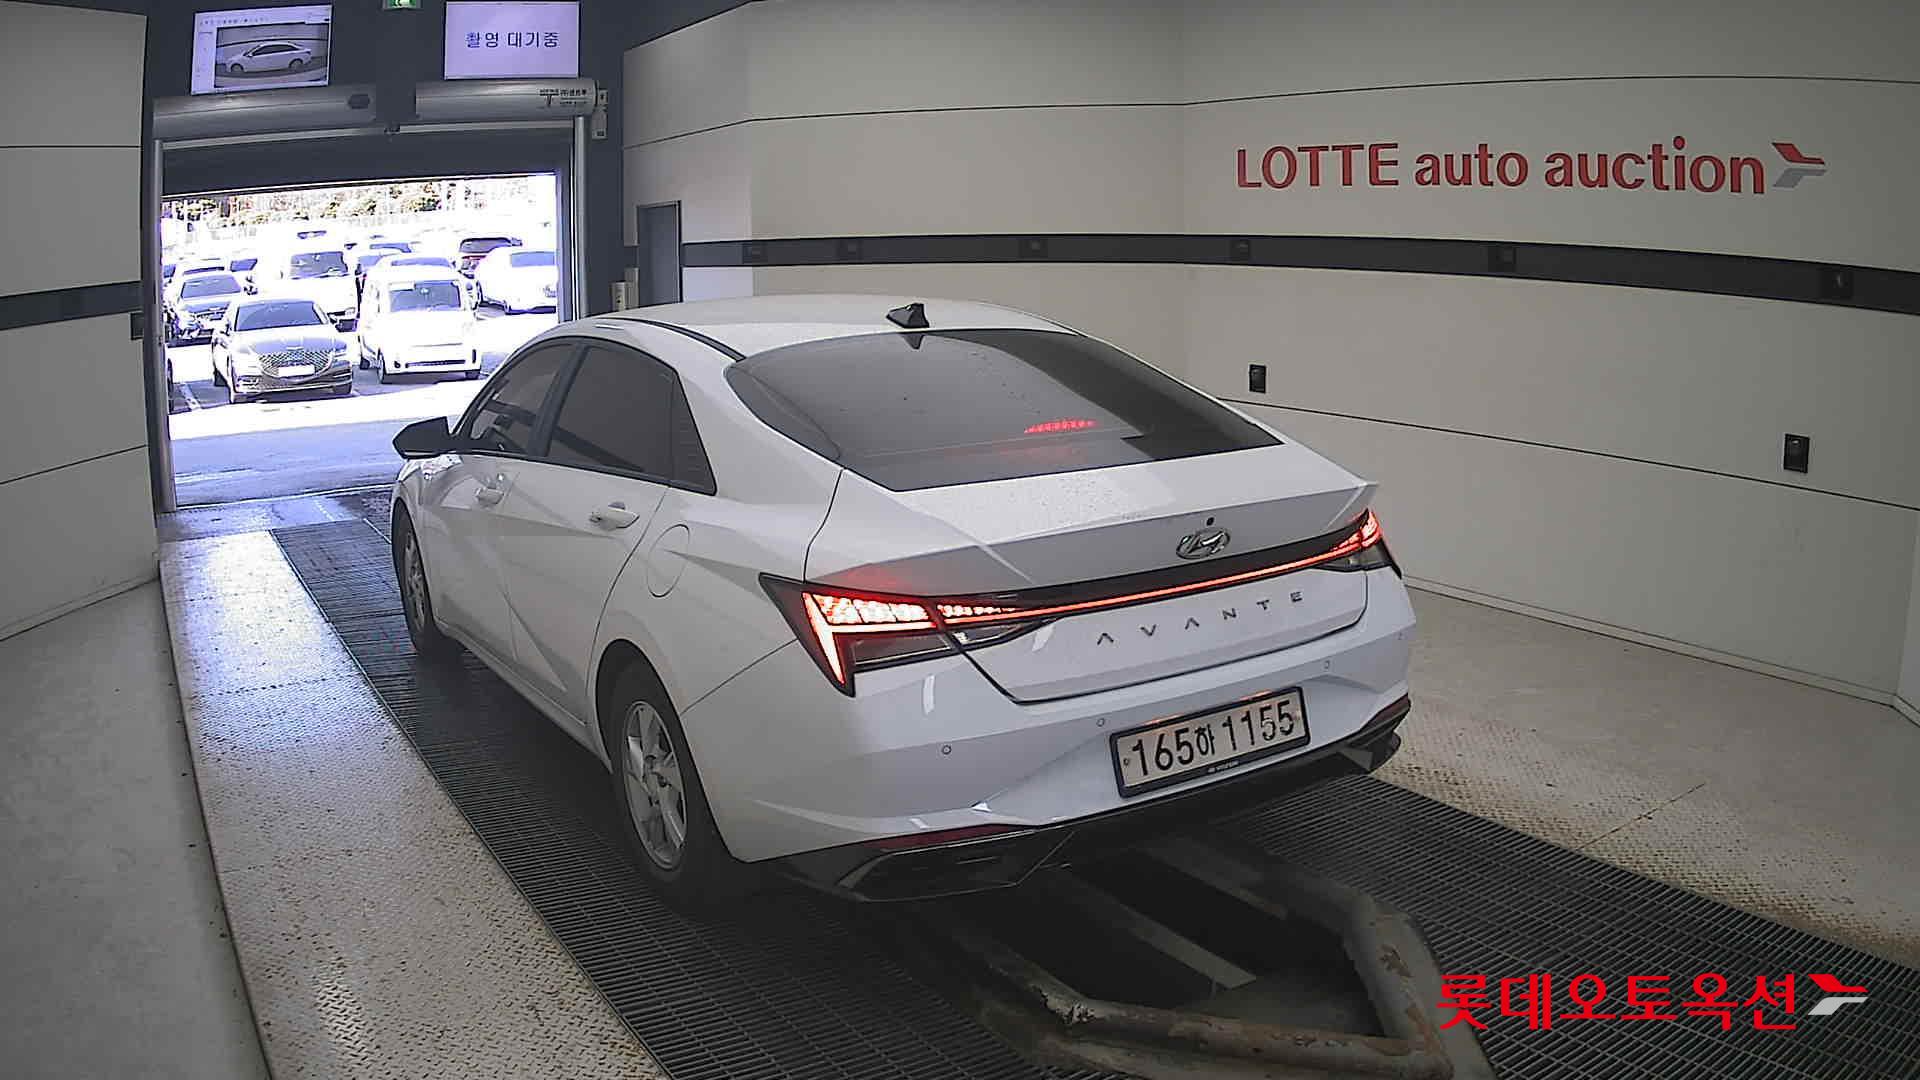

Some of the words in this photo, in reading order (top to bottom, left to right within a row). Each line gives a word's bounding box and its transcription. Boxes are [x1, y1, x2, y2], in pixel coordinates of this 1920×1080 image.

[465, 31, 499, 48] 촬영
[507, 30, 560, 48] 대기중
[1237, 142, 1400, 188] LOTTE
[1414, 143, 1529, 187] auto
[1544, 136, 1767, 194] auction
[1096, 590, 1304, 646] AVANTE
[1131, 723, 1215, 776] 165하
[1222, 700, 1295, 751] 1155
